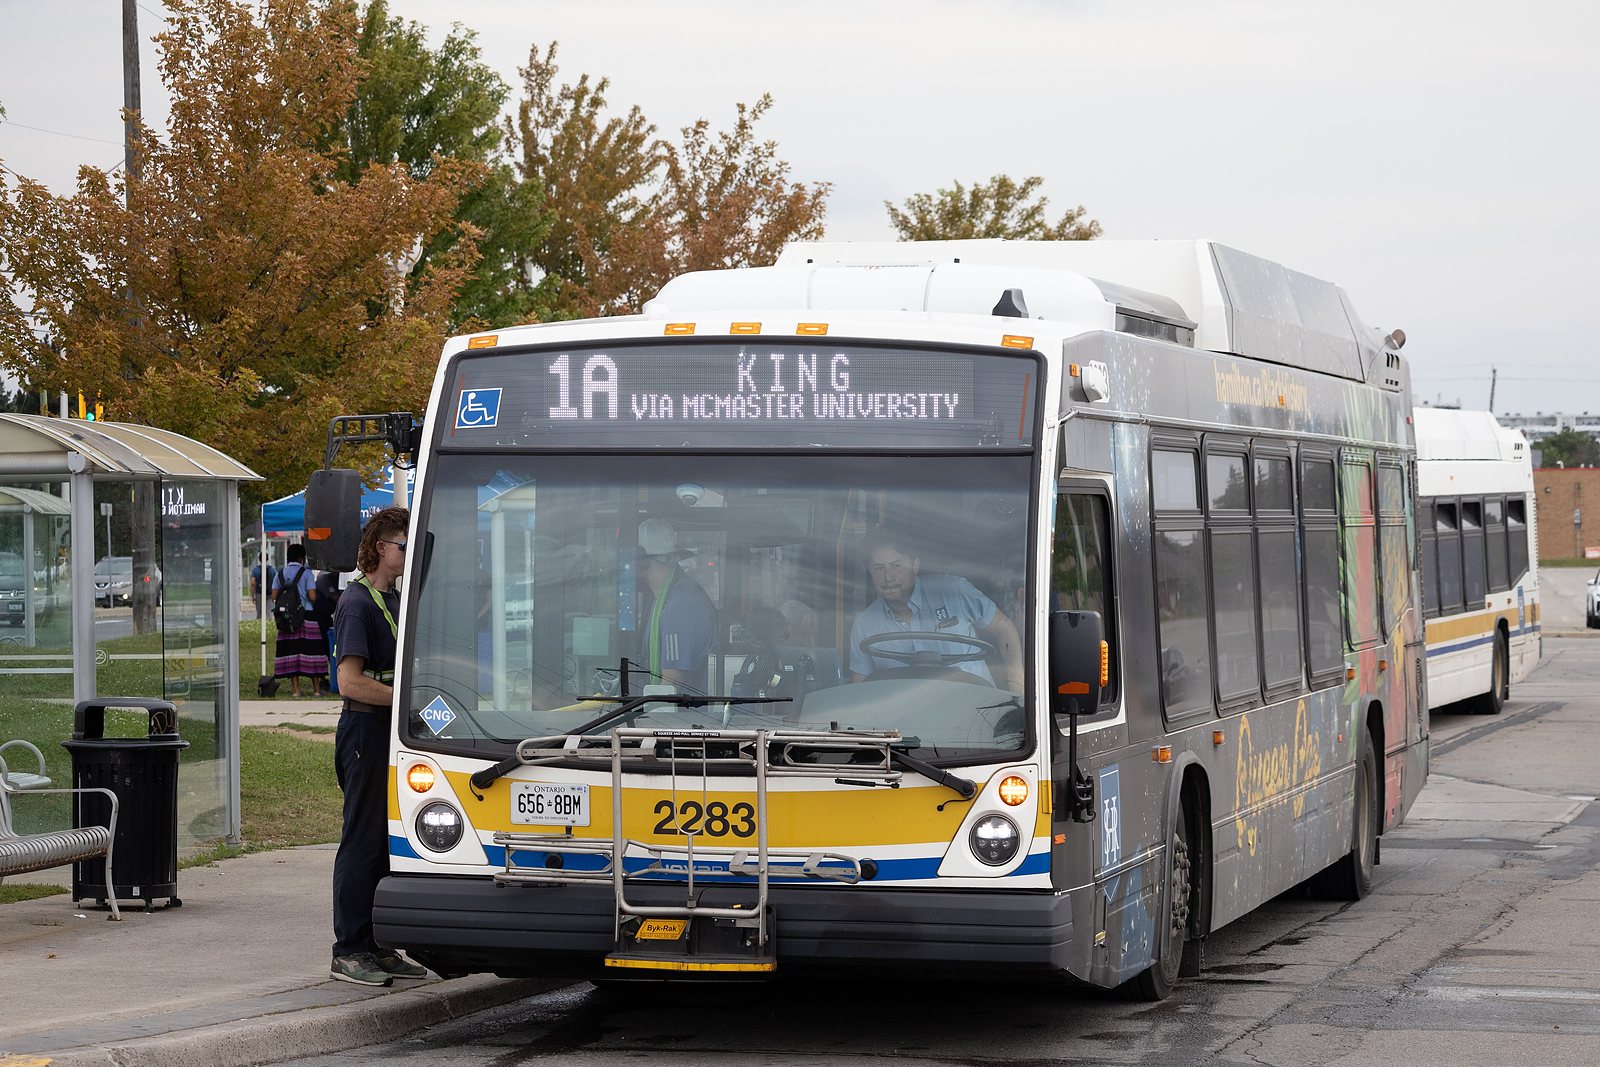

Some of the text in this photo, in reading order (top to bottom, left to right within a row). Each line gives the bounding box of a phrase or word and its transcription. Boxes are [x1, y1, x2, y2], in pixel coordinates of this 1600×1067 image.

[737, 352, 850, 392] KING
[549, 354, 618, 419] 1A
[631, 393, 959, 420] VIA MCMASTER UNIVERSITY
[424, 708, 451, 722] CNG
[518, 793, 581, 816] 656 8BM
[653, 799, 757, 839] 2283
[646, 924, 677, 933] Byk-Rak
